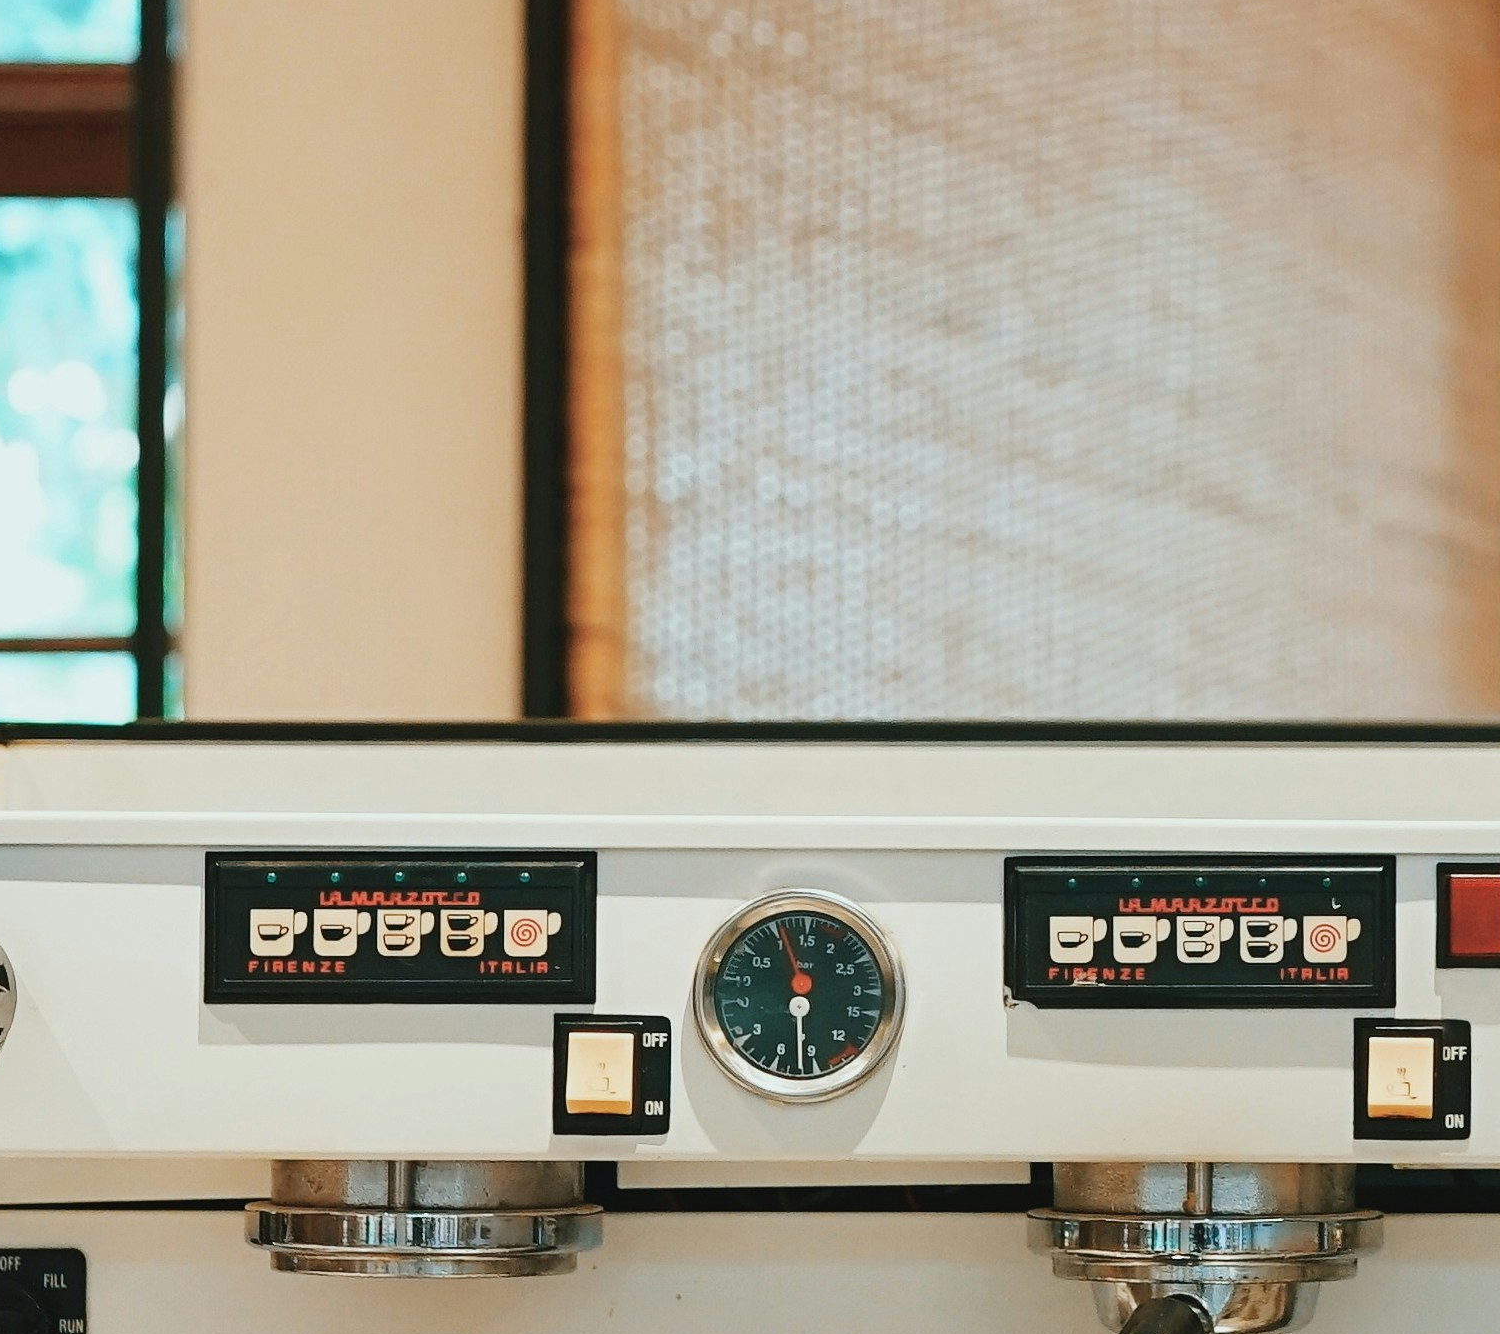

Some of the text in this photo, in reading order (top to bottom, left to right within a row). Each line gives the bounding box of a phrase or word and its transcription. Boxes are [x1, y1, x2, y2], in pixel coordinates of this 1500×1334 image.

[777, 939, 783, 951] 1
[798, 934, 816, 948] 1,5
[826, 943, 835, 954] 2
[248, 960, 549, 974] FIRENZE ITALIA
[752, 956, 771, 970] 0,5
[797, 960, 814, 969] bar
[835, 963, 855, 976] 2,5
[1048, 967, 1349, 981] FIRENZE ITALIA
[852, 985, 862, 997] 3
[846, 1006, 861, 1018] 15
[752, 1023, 762, 1035] 3
[831, 1029, 846, 1042] 12
[642, 1032, 669, 1048] OFF
[776, 1043, 786, 1055] 6
[807, 1045, 816, 1057] 9
[1442, 1046, 1468, 1061] OFF
[644, 1100, 664, 1116] ON
[1444, 1113, 1465, 1129] ON
[0, 1255, 22, 1271] OFF
[43, 1273, 68, 1288] FILL
[58, 1318, 85, 1334] RUN
